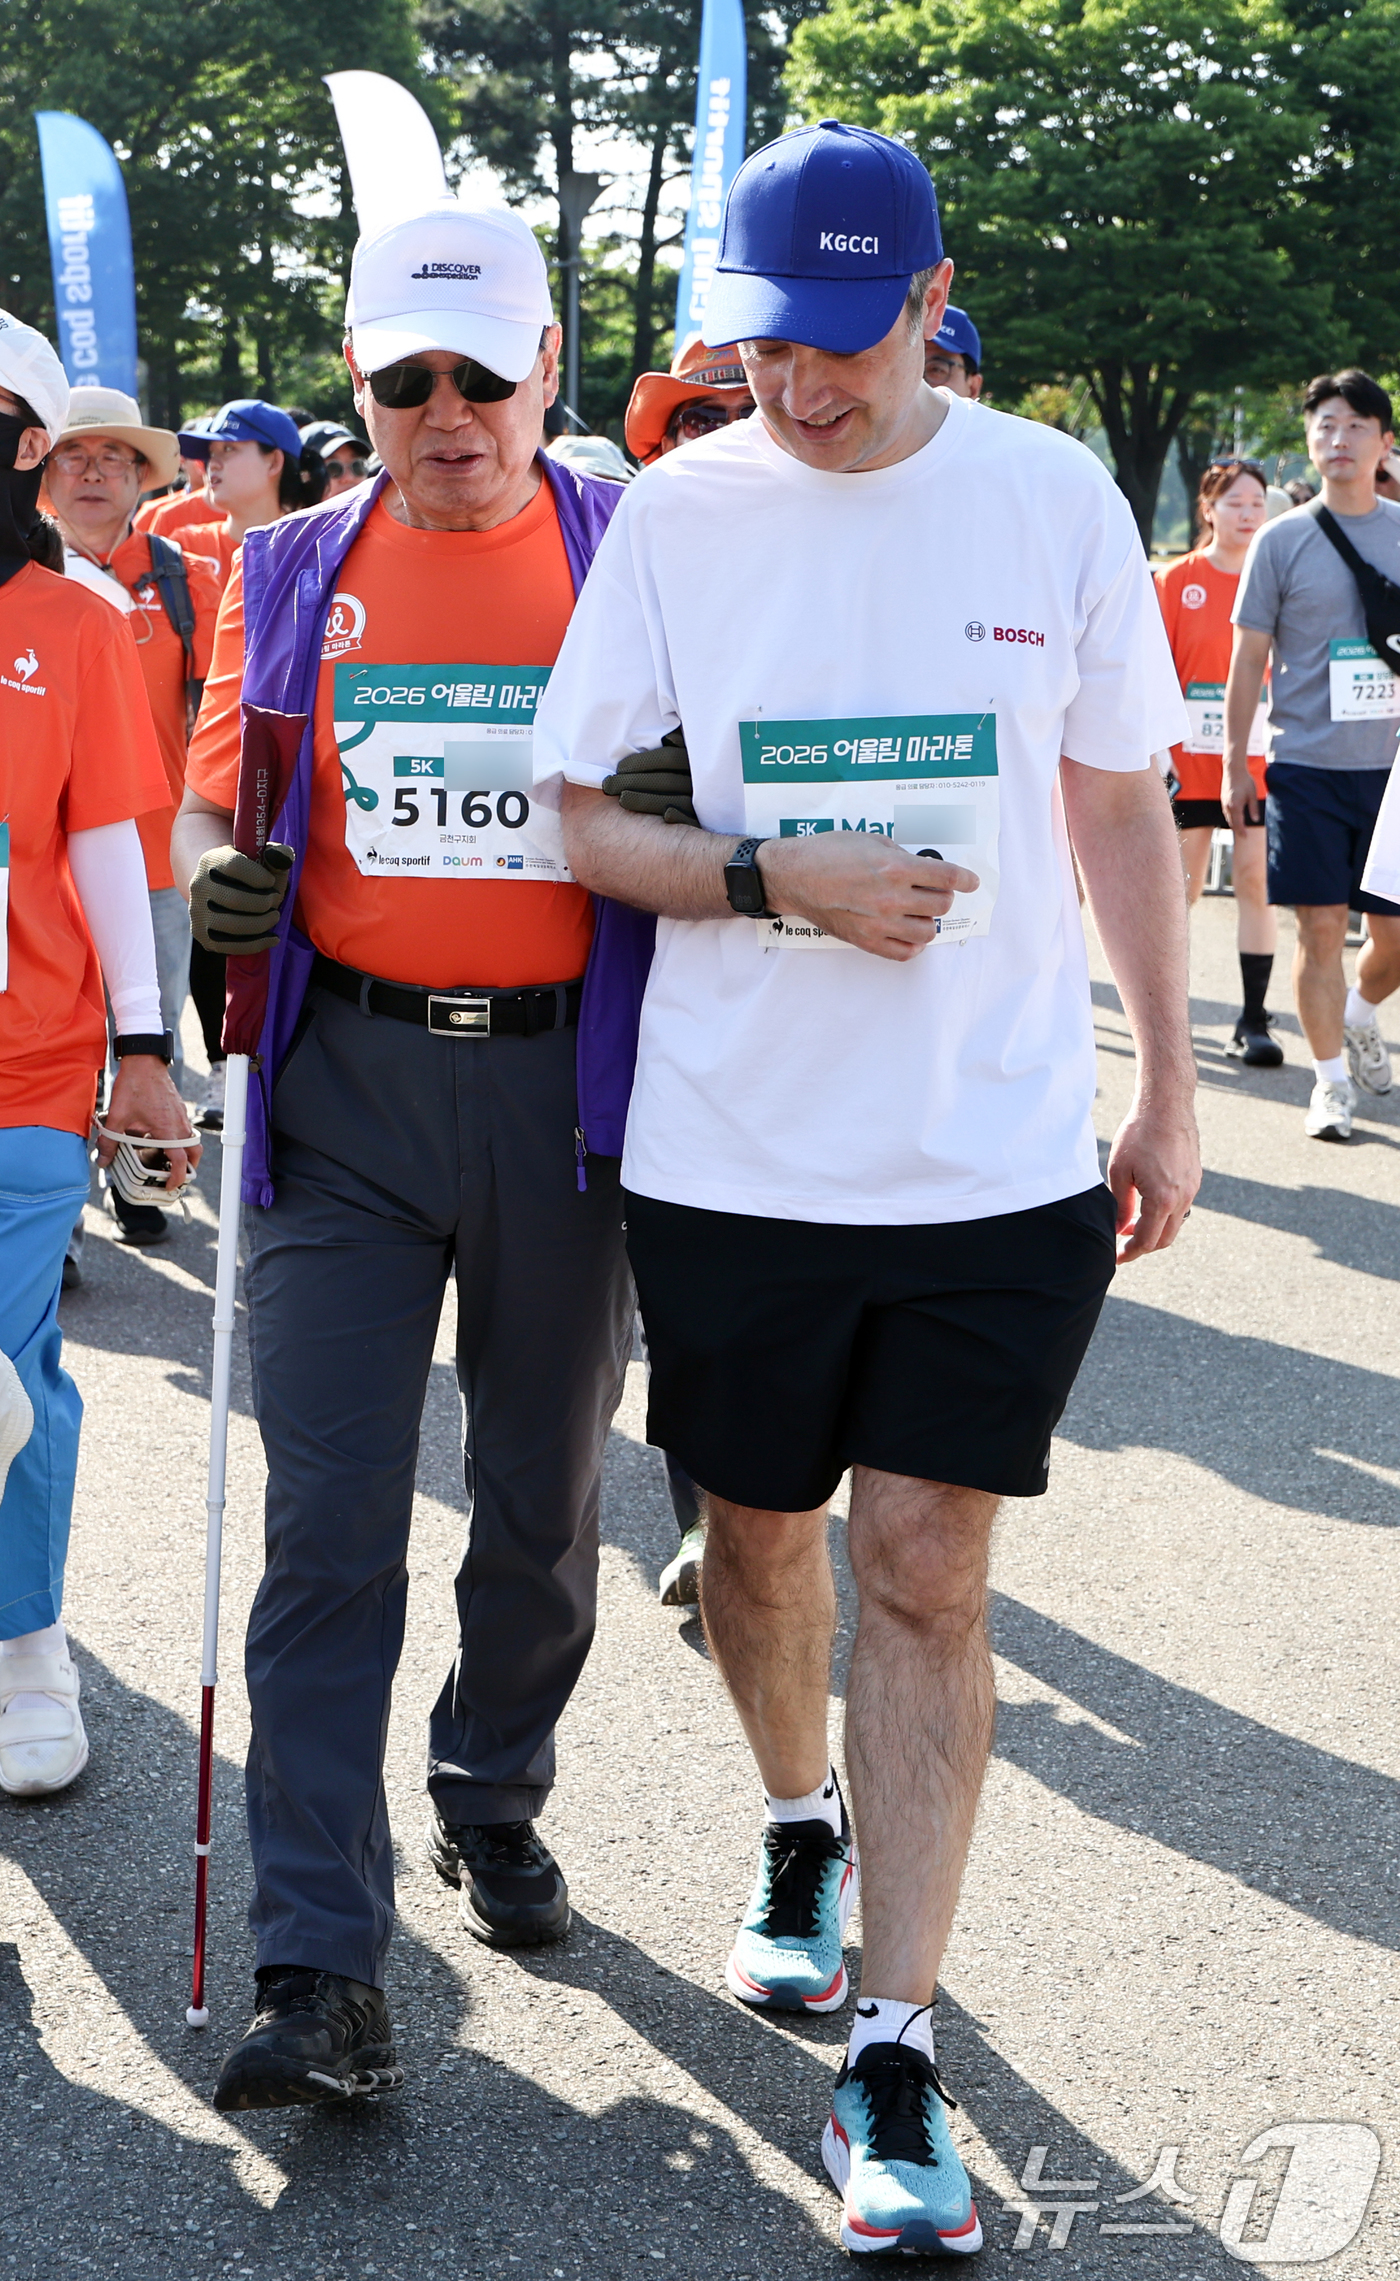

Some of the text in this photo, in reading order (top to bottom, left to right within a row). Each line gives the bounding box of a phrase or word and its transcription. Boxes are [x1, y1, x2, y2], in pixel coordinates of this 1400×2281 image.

[820, 231, 879, 255] KGCCI
[431, 263, 481, 275] DISCOVER
[993, 626, 1045, 648] BOSCH
[353, 683, 545, 709] 2026 어울림 마라
[1352, 684, 1395, 701] 7223
[760, 734, 974, 765] 2026 어울림 마라톤
[410, 759, 434, 774] 5K
[391, 787, 530, 829] 5160
[796, 822, 818, 836] 5K
[439, 834, 477, 844] 금천구지회
[401, 856, 431, 867] sportif
[786, 924, 794, 936] le
[795, 926, 811, 938] coq
